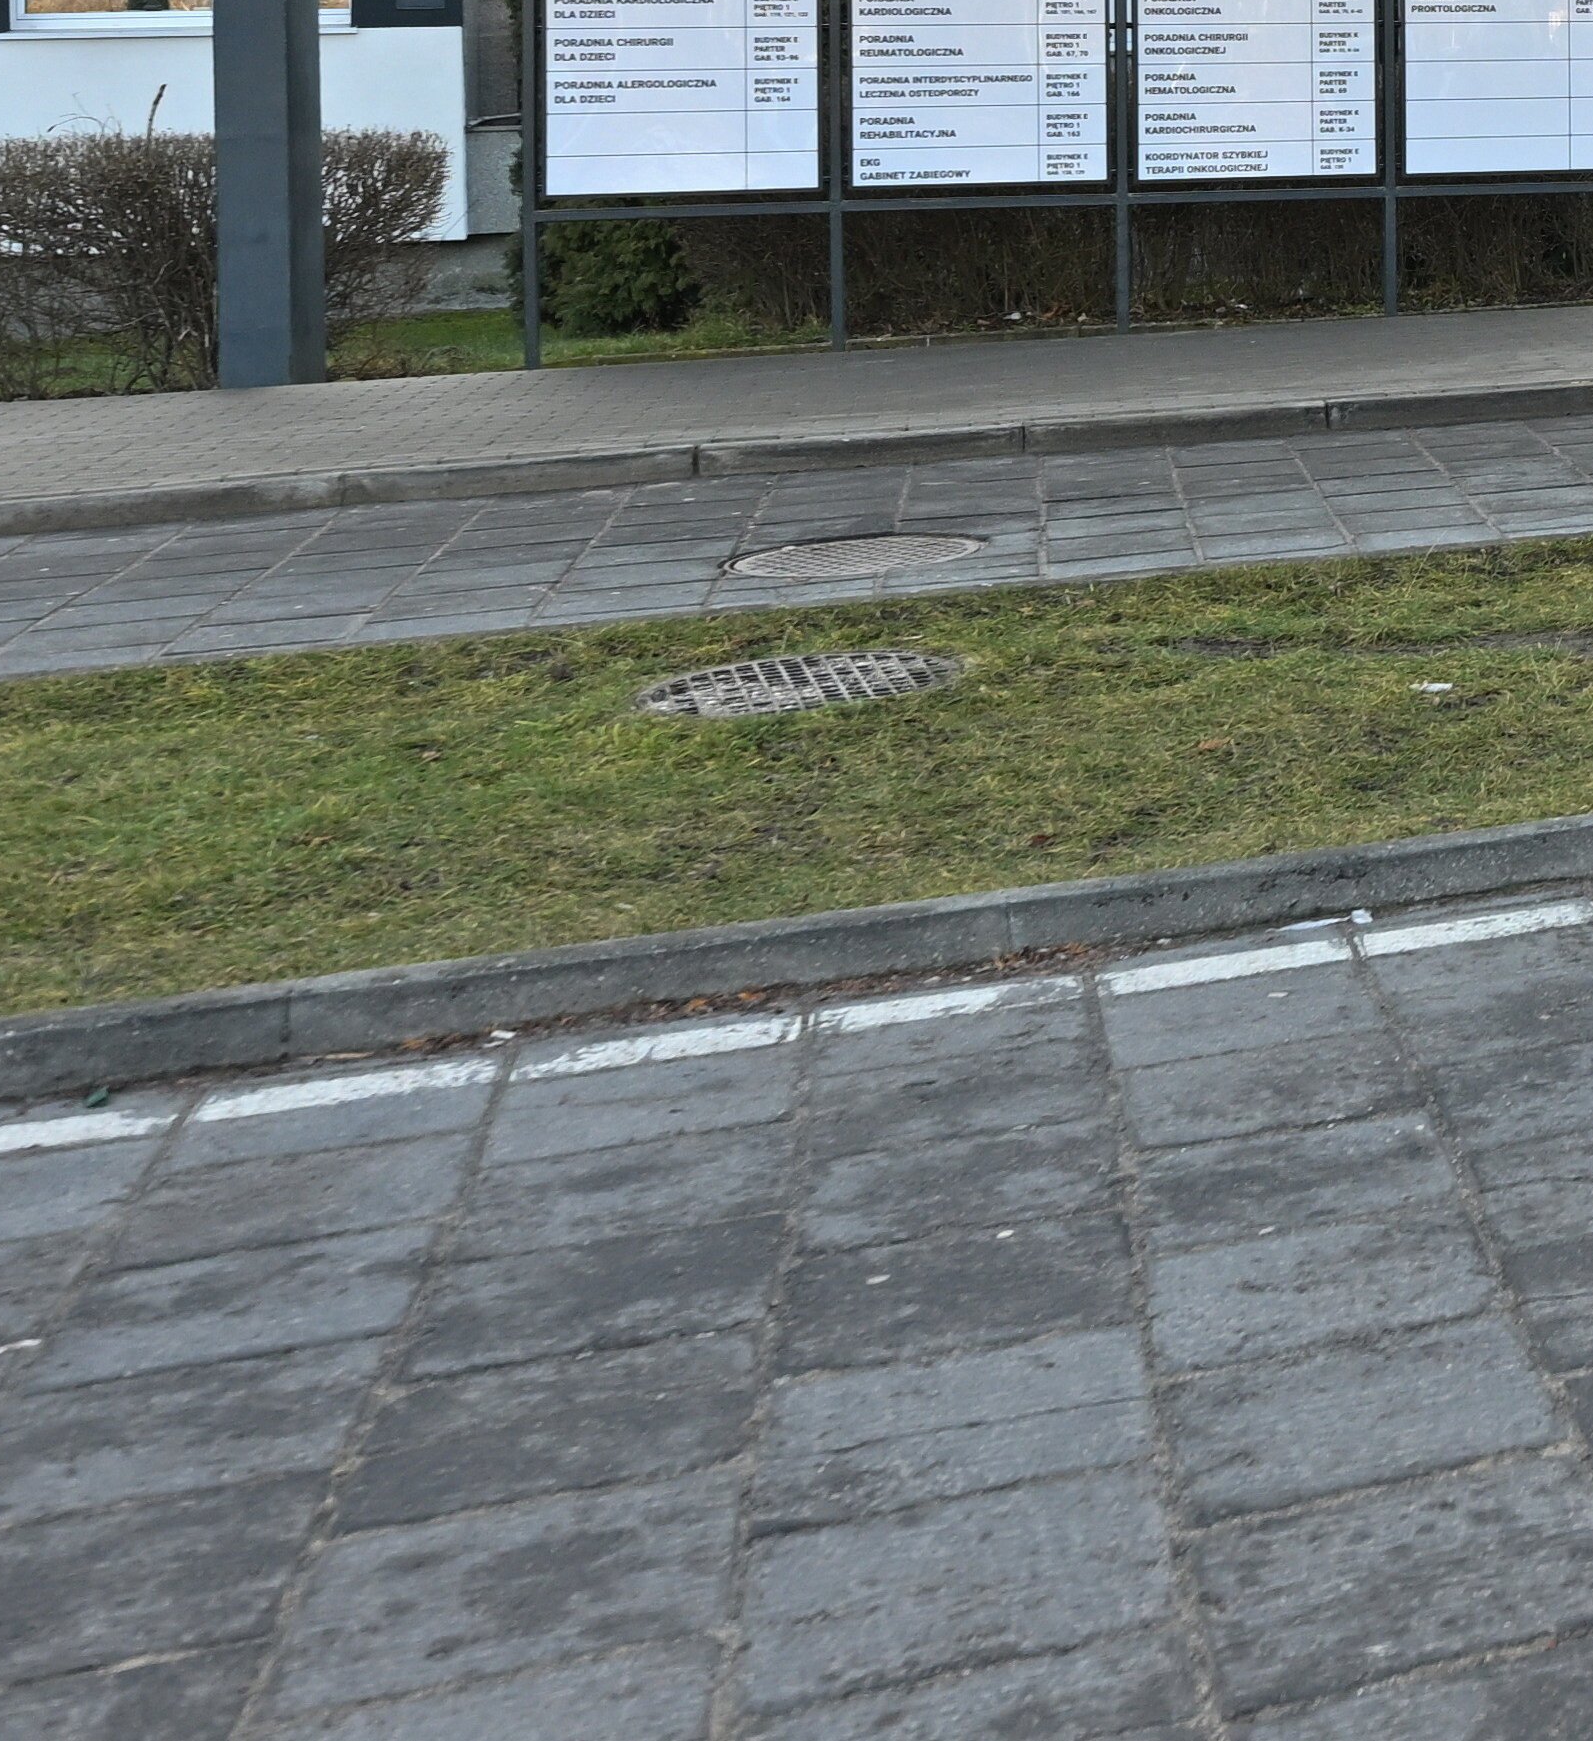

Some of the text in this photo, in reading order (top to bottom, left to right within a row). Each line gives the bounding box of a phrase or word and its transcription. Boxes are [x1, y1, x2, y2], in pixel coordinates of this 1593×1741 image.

[859, 7, 952, 16] KARDIOLOGICZNA
[1144, 7, 1222, 15] ONKOLOGICZNA
[1411, 5, 1496, 13] PROKTOLOGICZNA
[554, 10, 615, 19] DLA DZIECI
[1144, 33, 1248, 42] PORADNIA CHIRURGII
[554, 38, 674, 47] PORADNIA CHIRURGII
[859, 48, 964, 57] REUMATOLOGICZNA
[1144, 46, 1226, 55] ONKOLOGICZNEJ
[554, 52, 615, 61] DLA DZIECI
[912, 75, 1033, 84] INTERDYSCYPLINARNEGO
[554, 79, 717, 90] PORADNIA ALERGOLOGICZNA
[859, 89, 979, 98] LECZENIA OSTEOPOROZY
[1145, 86, 1236, 95] HEMATOLOGICZNA
[554, 95, 616, 104] DLA DZIECI
[860, 130, 956, 139] REHABILITACYJNA
[1145, 125, 1256, 135] KARDIOCHIRURGICZNA
[1145, 150, 1268, 161] KOORDYNATOR SZYBKIEJ
[860, 158, 880, 167] EKG
[1145, 164, 1268, 174] TERAPII ONKOLOGICZNEJ
[860, 170, 971, 180] GABINET ZABIEGOWY
